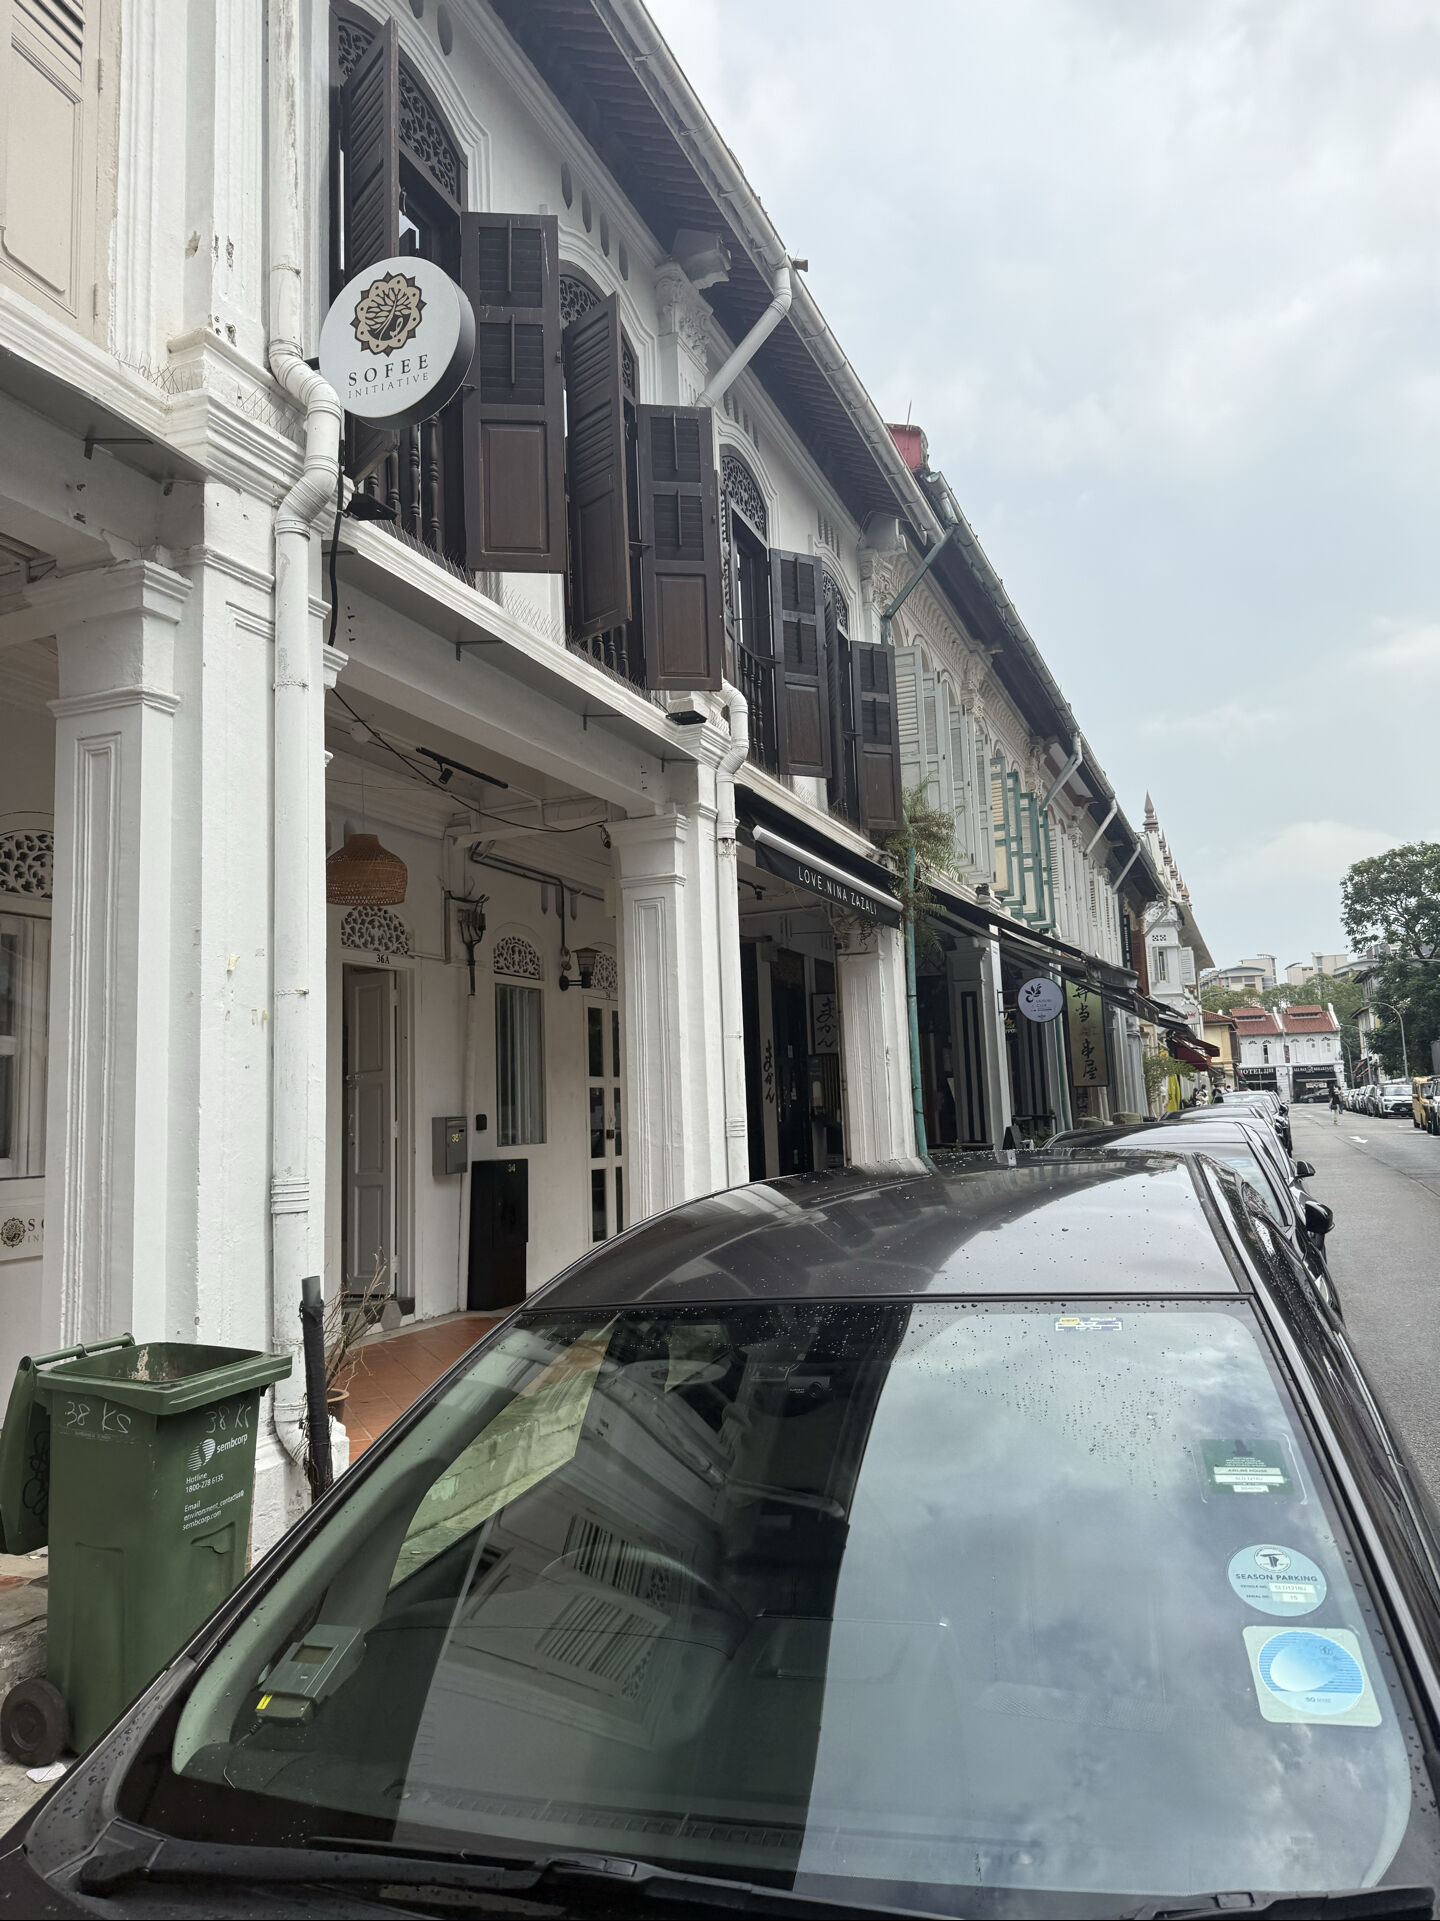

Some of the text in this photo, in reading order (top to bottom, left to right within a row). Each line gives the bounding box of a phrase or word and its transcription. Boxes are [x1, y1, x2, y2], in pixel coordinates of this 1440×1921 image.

[348, 353, 429, 387] SOFEE
[348, 372, 429, 399] INITIATIVE
[850, 892, 877, 915] ZAZALI
[376, 953, 390, 965] 36A
[64, 1400, 91, 1427] 38
[204, 1405, 231, 1434] 38
[216, 1433, 249, 1454] sembcorp
[185, 1472, 208, 1485] Hotline
[184, 1500, 201, 1513] Email
[182, 1510, 222, 1531] sembcorp.com
[1235, 1573, 1319, 1583] SEASON PARKING
